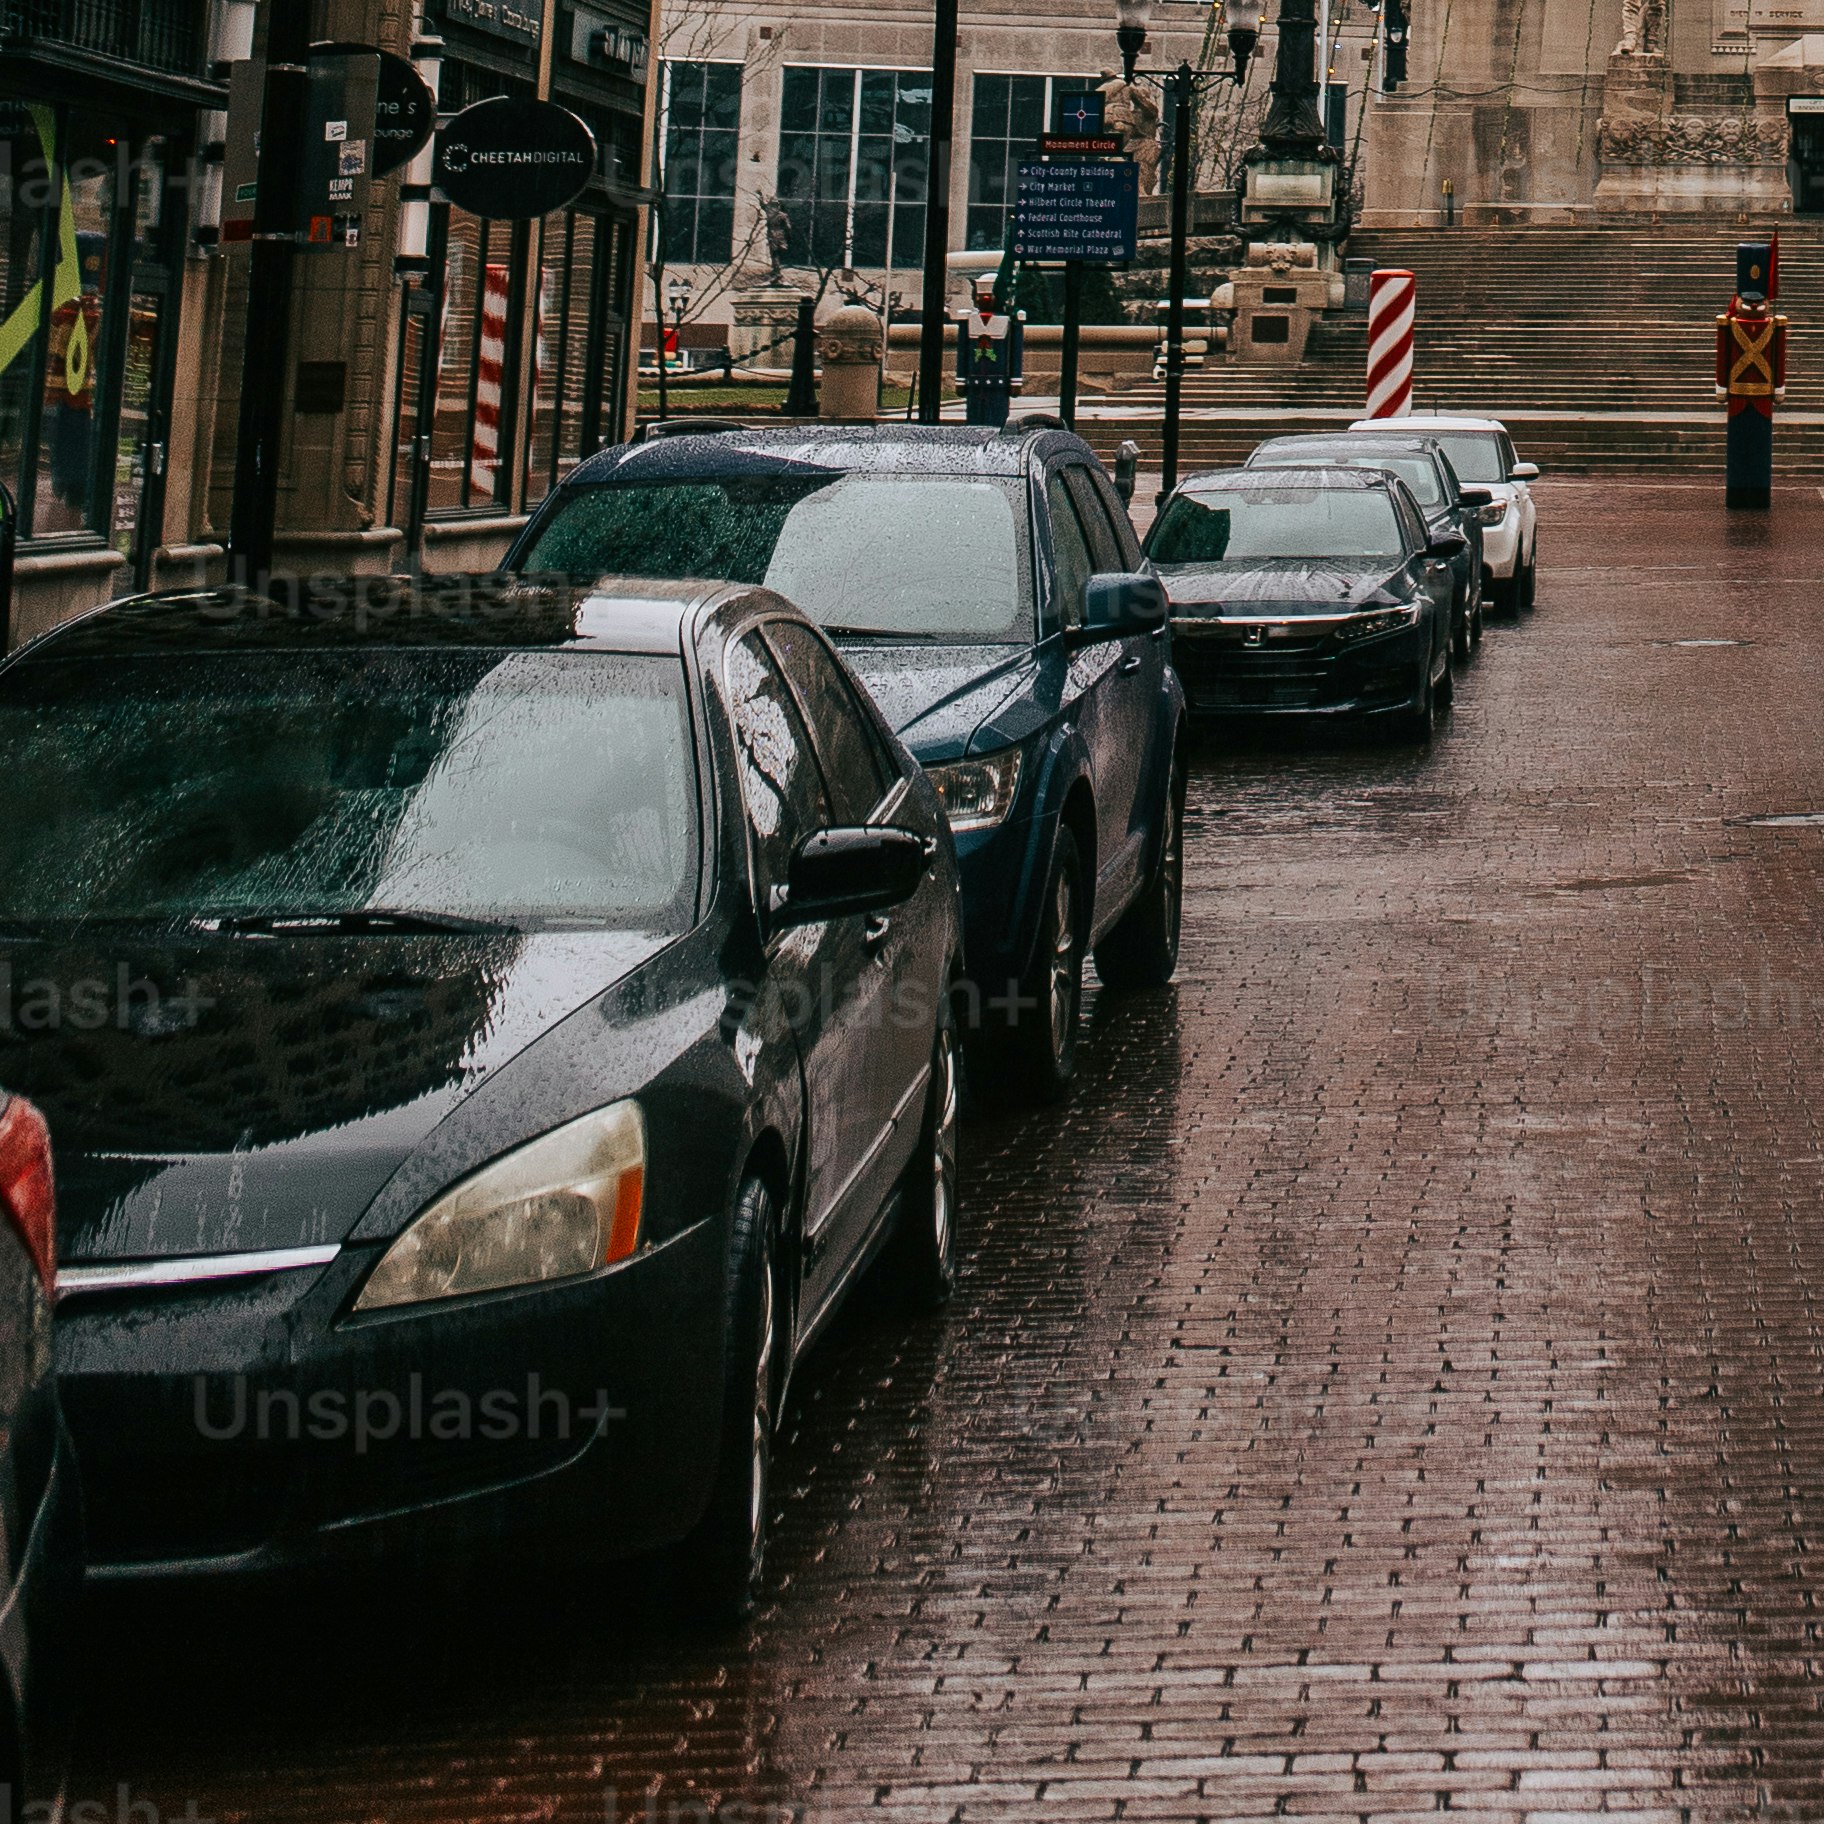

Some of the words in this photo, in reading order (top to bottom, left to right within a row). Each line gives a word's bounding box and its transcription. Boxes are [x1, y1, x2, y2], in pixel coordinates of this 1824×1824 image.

[1045, 141, 1088, 149] Monument
[1092, 141, 1116, 149] Circle
[1030, 166, 1077, 177] City-County
[1080, 167, 1115, 178] Building
[1030, 183, 1045, 192] City
[1048, 183, 1075, 191] Market
[1029, 198, 1056, 206] Hilbert
[1060, 198, 1082, 207] Circle
[1086, 199, 1116, 207] Theatre
[1028, 213, 1056, 222] Federal
[1060, 214, 1102, 222] Courthouse
[1028, 229, 1060, 238] Scottish
[1063, 229, 1078, 238] Rite
[1082, 230, 1122, 239] Cathedral
[1028, 245, 1042, 253] War
[1046, 245, 1084, 253] Memorial
[1088, 246, 1108, 254] Plaza
